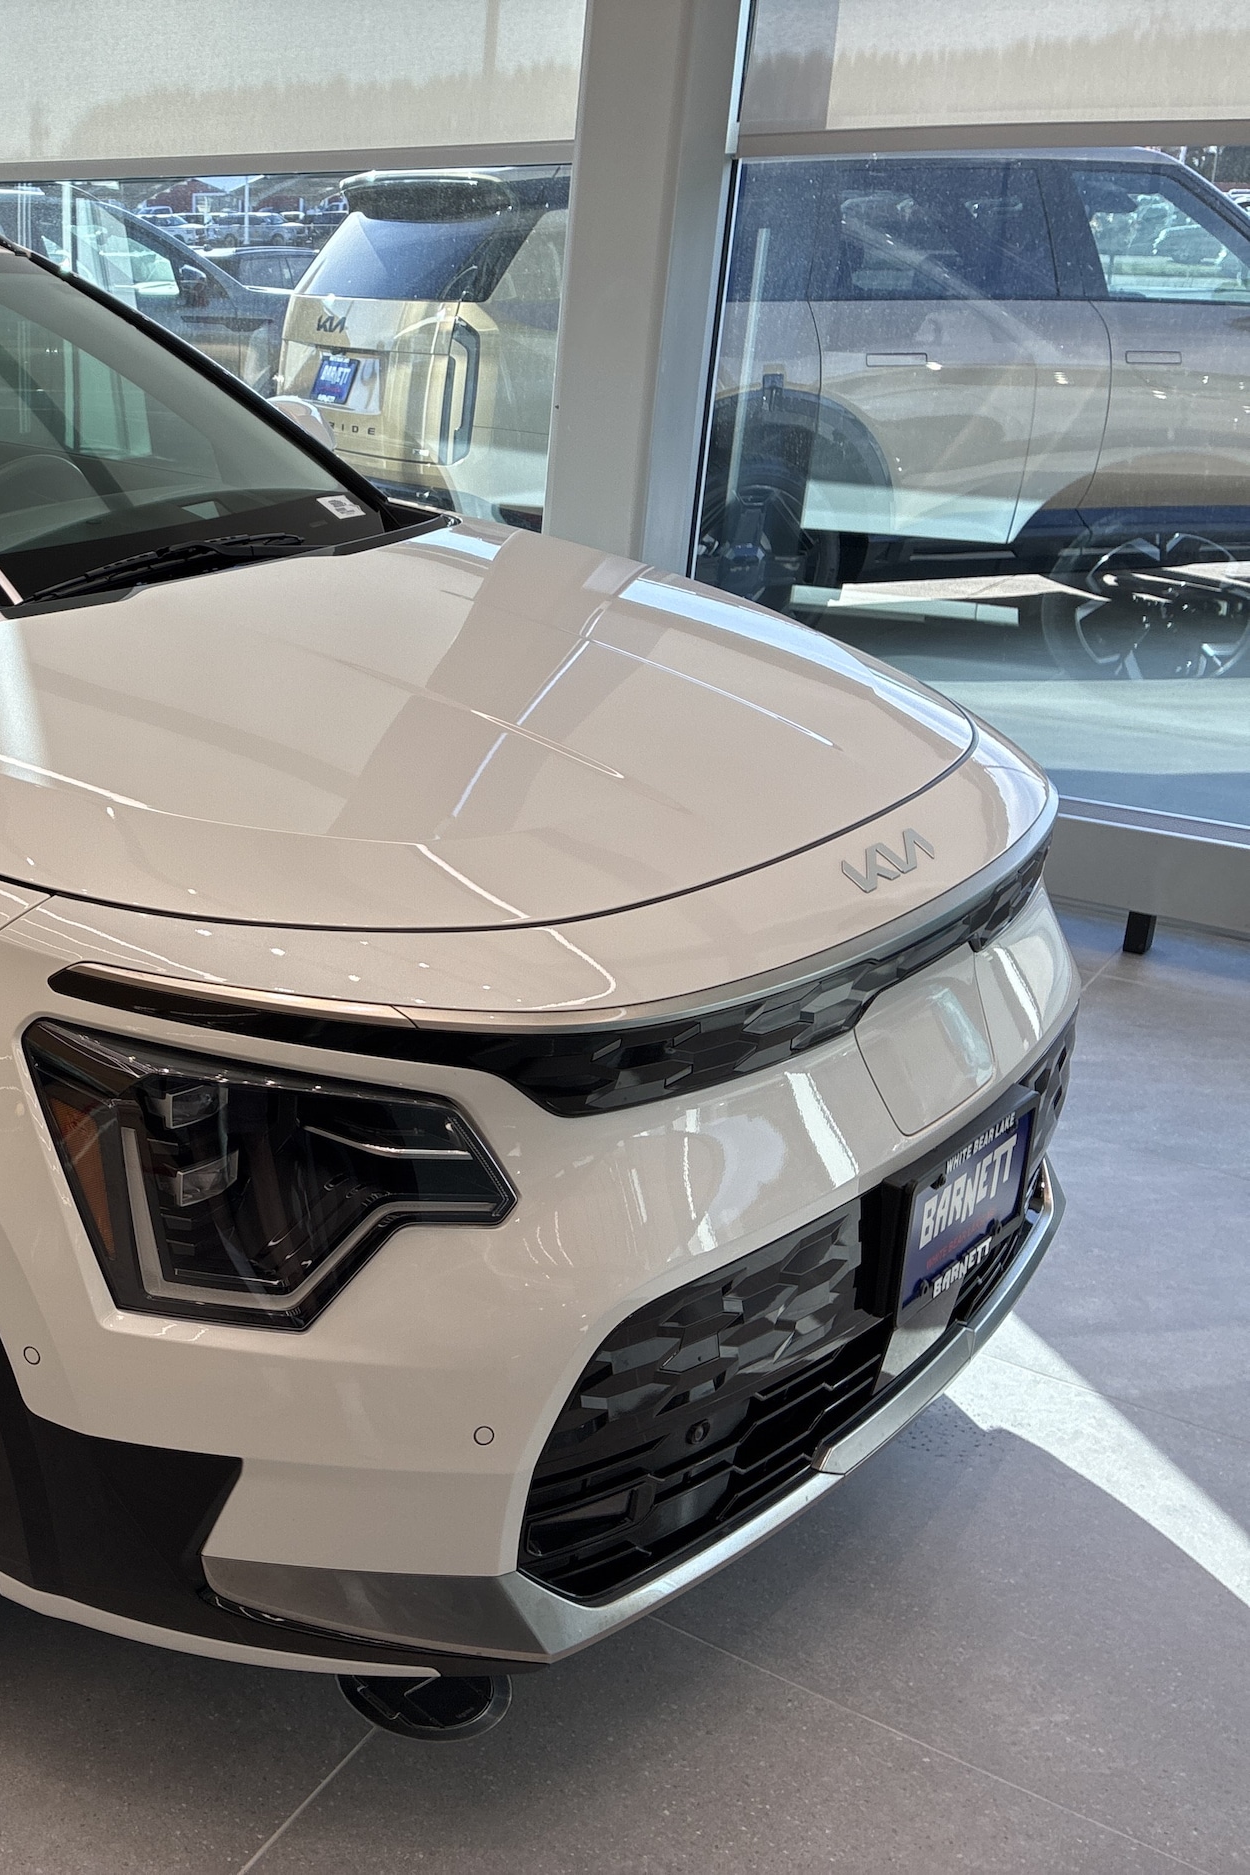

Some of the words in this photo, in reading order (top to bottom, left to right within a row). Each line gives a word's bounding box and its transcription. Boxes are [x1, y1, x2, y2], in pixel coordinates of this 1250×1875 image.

[316, 314, 347, 334] KIA
[841, 827, 935, 894] KIA
[945, 1149, 972, 1174] WHITE
[971, 1130, 995, 1157] BEAR
[993, 1112, 1017, 1140] LAKE
[918, 1133, 1018, 1250] BARNETT
[932, 1236, 993, 1299] BARNETT
